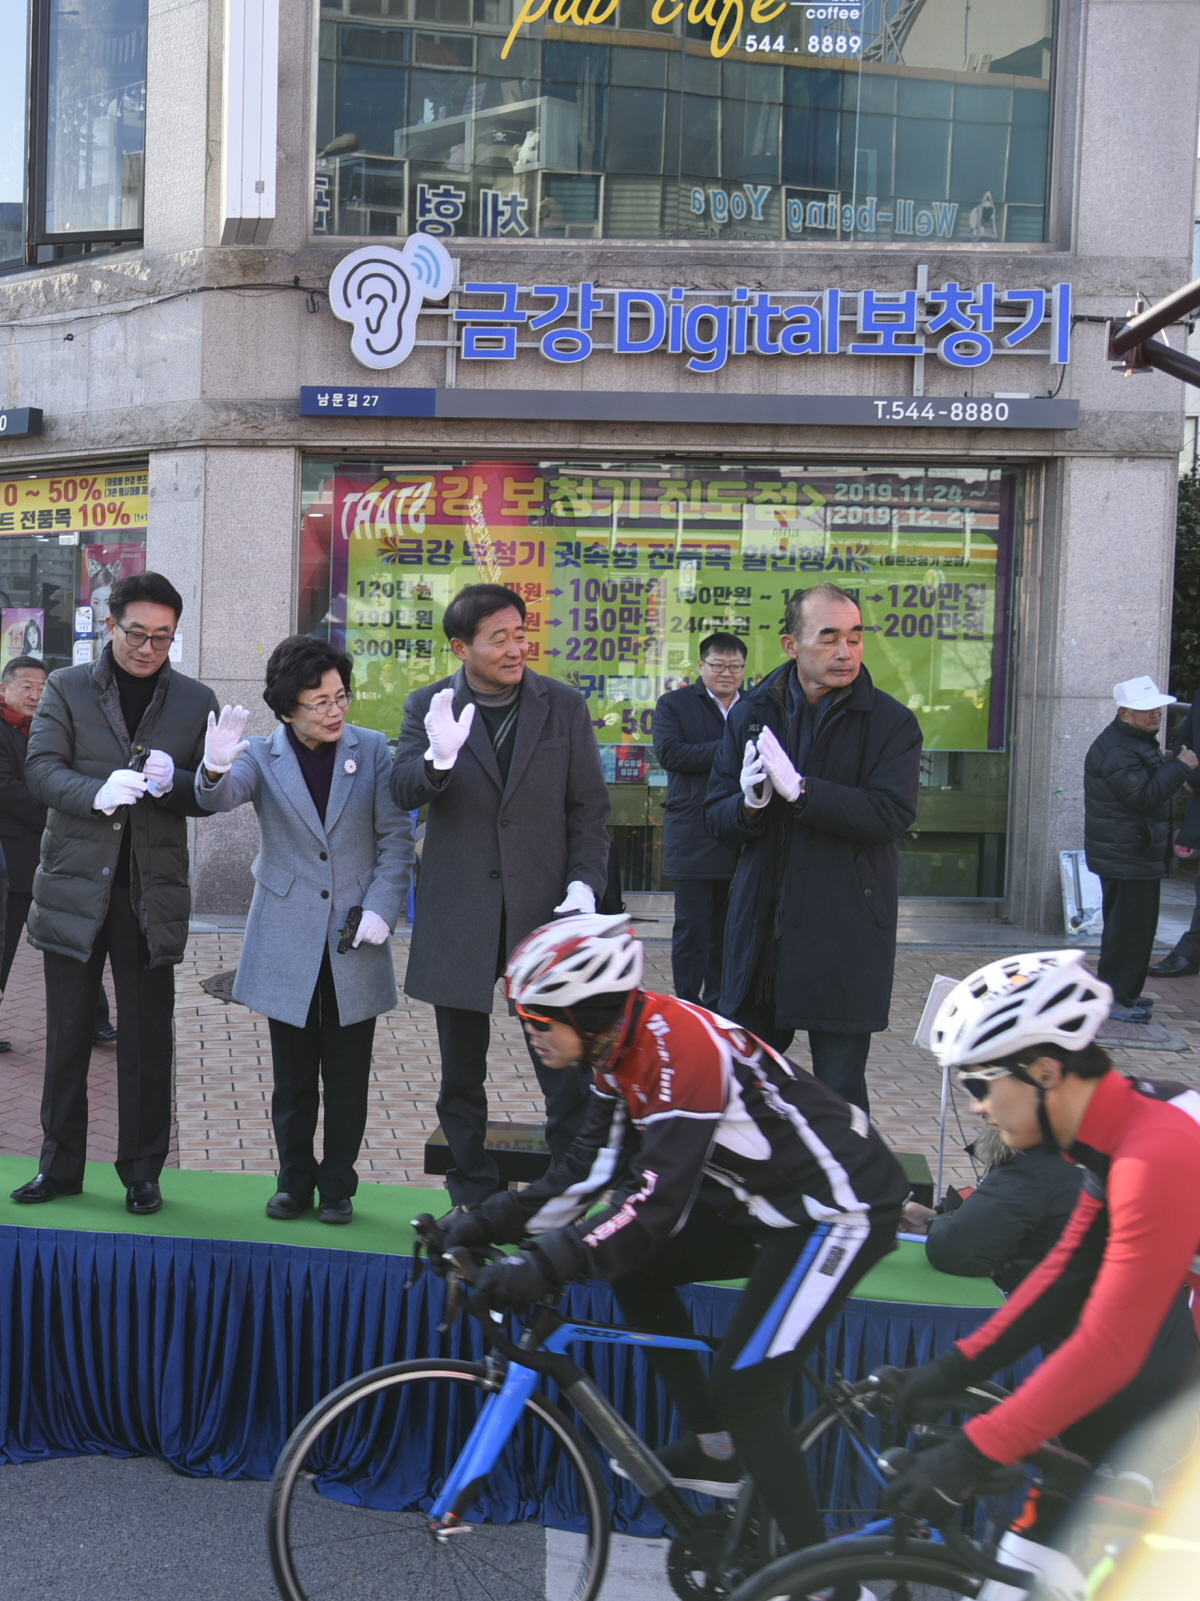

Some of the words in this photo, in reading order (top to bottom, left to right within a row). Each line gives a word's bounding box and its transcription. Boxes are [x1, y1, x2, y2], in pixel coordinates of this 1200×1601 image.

[806, 7, 860, 20] coffee
[317, 393, 358, 408] 남문길
[362, 395, 379, 407] 27
[874, 401, 1009, 422] T.544-8880
[48, 477, 102, 504] 50%
[503, 477, 641, 520] 보청기
[20, 508, 72, 529] 전품목
[78, 501, 131, 528] 10%
[398, 539, 454, 566] 금강
[461, 540, 545, 567] 보청기
[554, 541, 639, 569] 귓속형
[647, 543, 731, 571] 전품목
[743, 544, 855, 573] 할인행사
[356, 580, 434, 601] 120만원
[569, 578, 667, 605] 100만원
[887, 583, 987, 610] 120만원
[356, 610, 434, 630] 190만원
[568, 607, 666, 636] 150만원
[884, 612, 985, 640] 200만원
[353, 639, 433, 659] 300만원
[565, 637, 666, 665] 220만원
